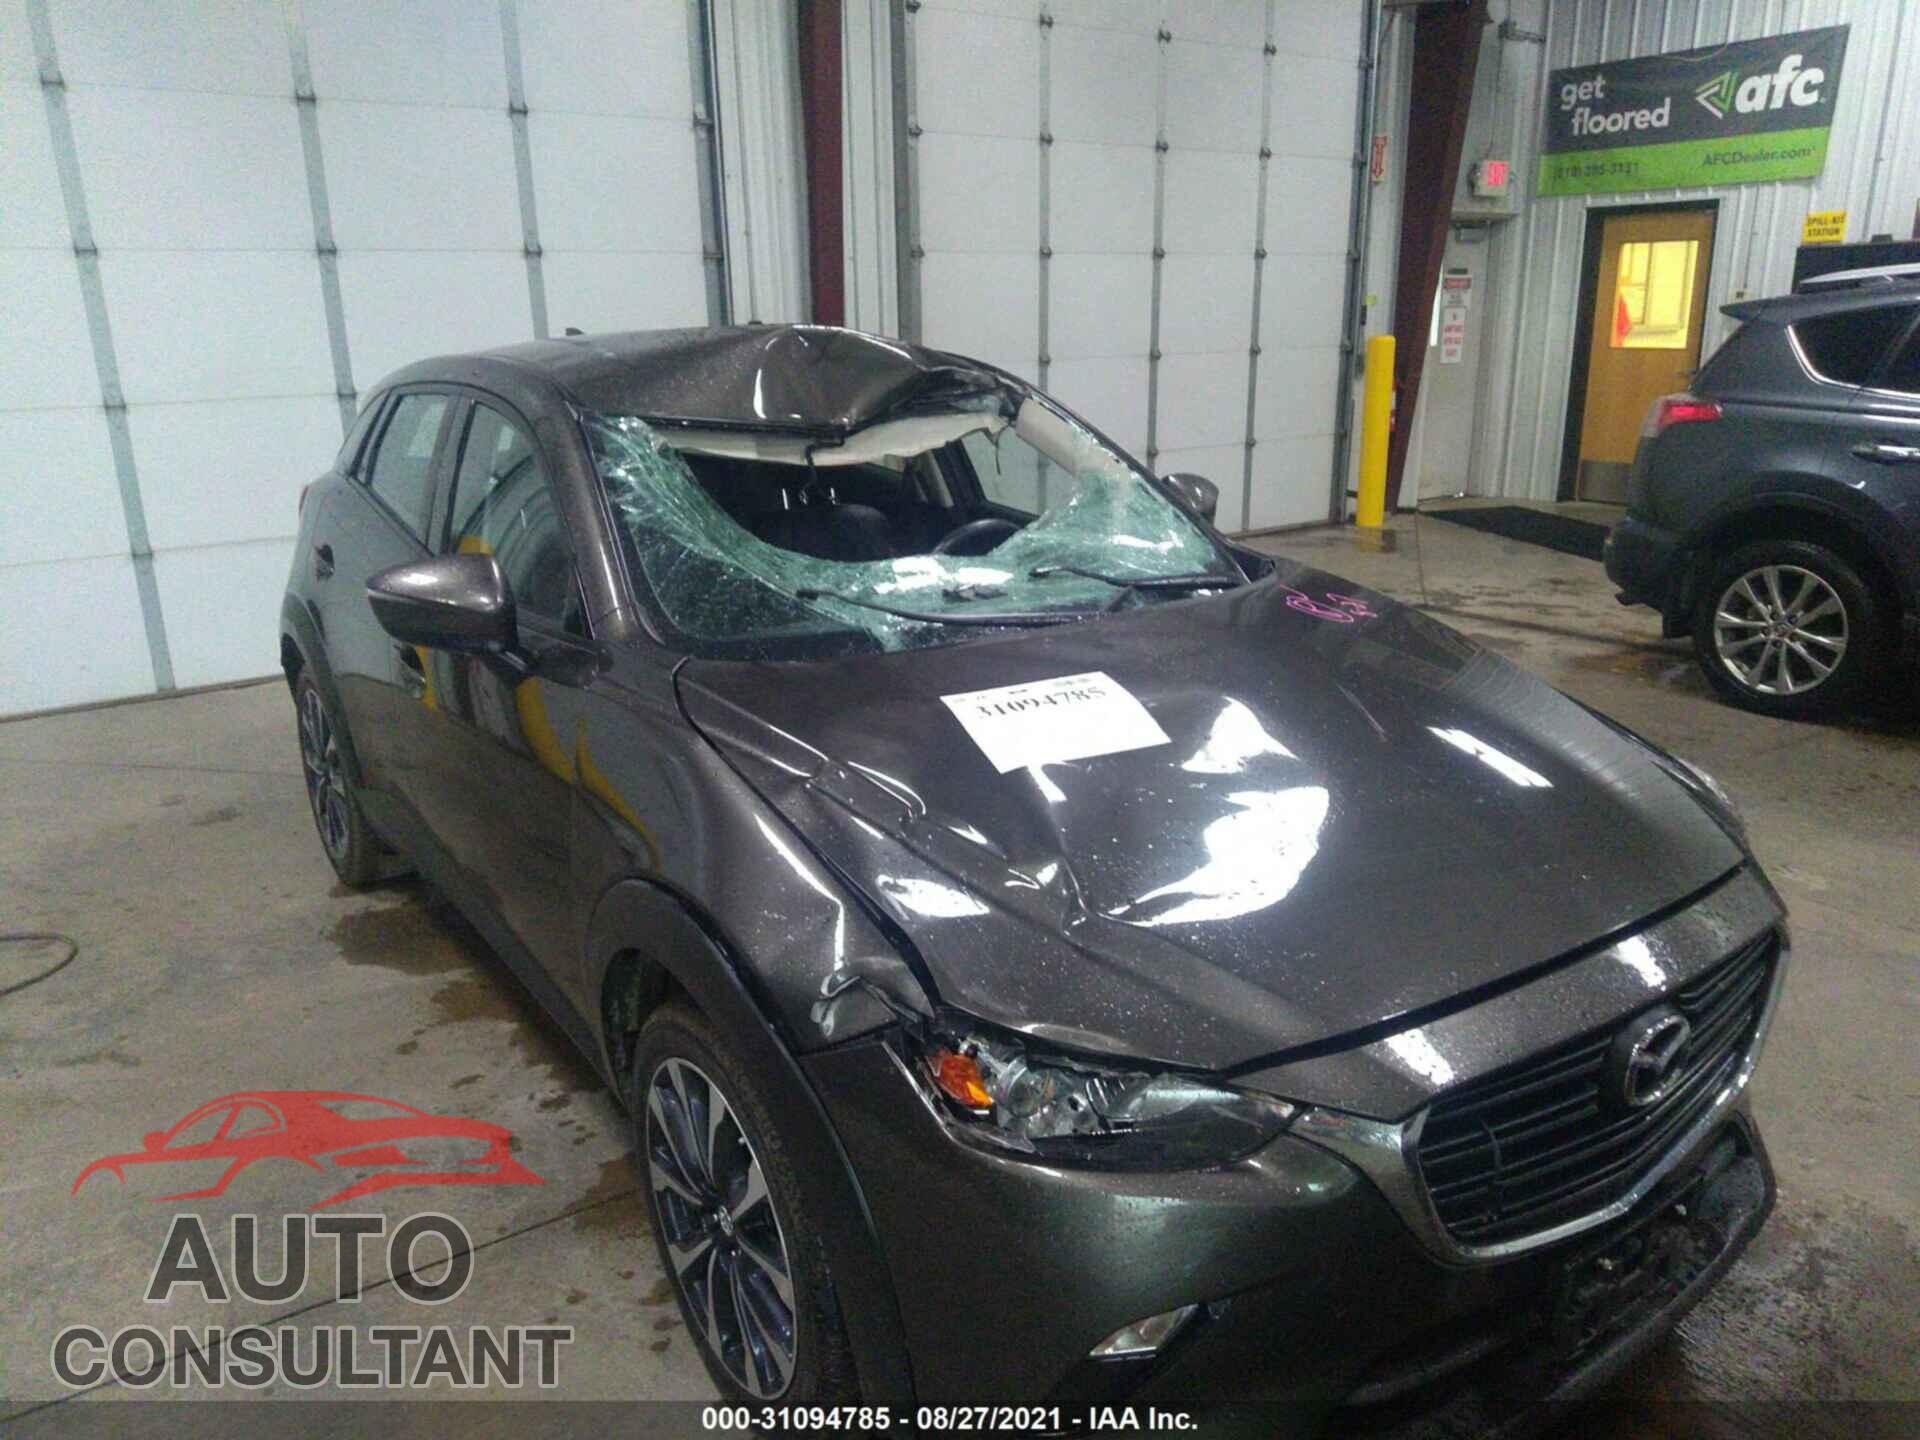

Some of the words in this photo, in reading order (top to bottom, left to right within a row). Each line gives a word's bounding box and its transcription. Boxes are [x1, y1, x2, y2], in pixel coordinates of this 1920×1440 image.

[1561, 74, 1605, 110] get
[1735, 54, 1824, 113] afc
[1572, 97, 1670, 136] floored
[1807, 227, 1841, 237] STATION
